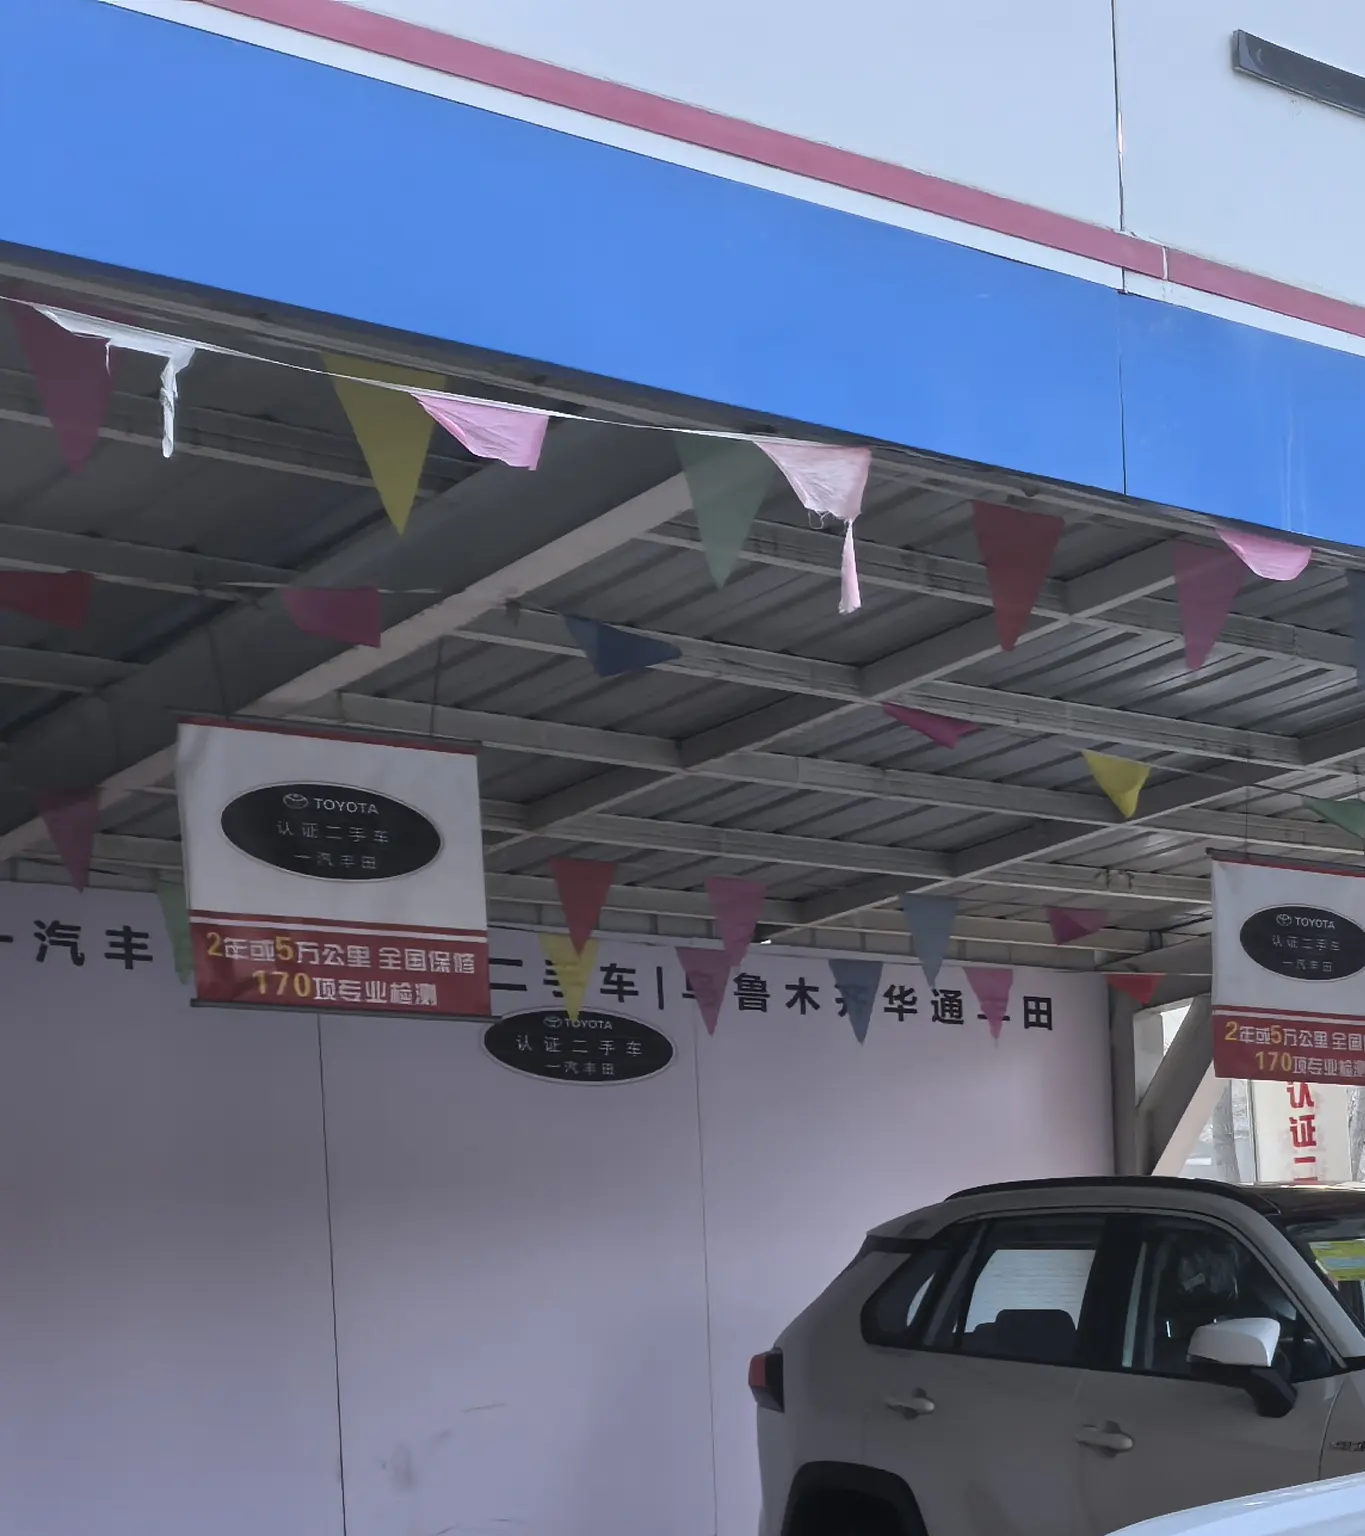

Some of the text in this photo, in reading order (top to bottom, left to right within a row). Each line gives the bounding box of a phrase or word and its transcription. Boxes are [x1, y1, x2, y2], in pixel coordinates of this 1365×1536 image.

[313, 797, 379, 815] TOYOTA
[276, 820, 390, 844] 认证二手车
[294, 852, 379, 870] 一汽丰田
[1294, 917, 1336, 930] TOYOTA
[0, 919, 153, 971] 汽丰
[206, 931, 476, 974] 2年或5万公里 全国保修
[252, 969, 438, 1006] 170项专业检测
[564, 1018, 613, 1030] TOYOTA
[1224, 1020, 1330, 1050] 2年或5万公里
[516, 1034, 643, 1057] 认证二手车
[545, 1060, 615, 1076] 一汽丰田
